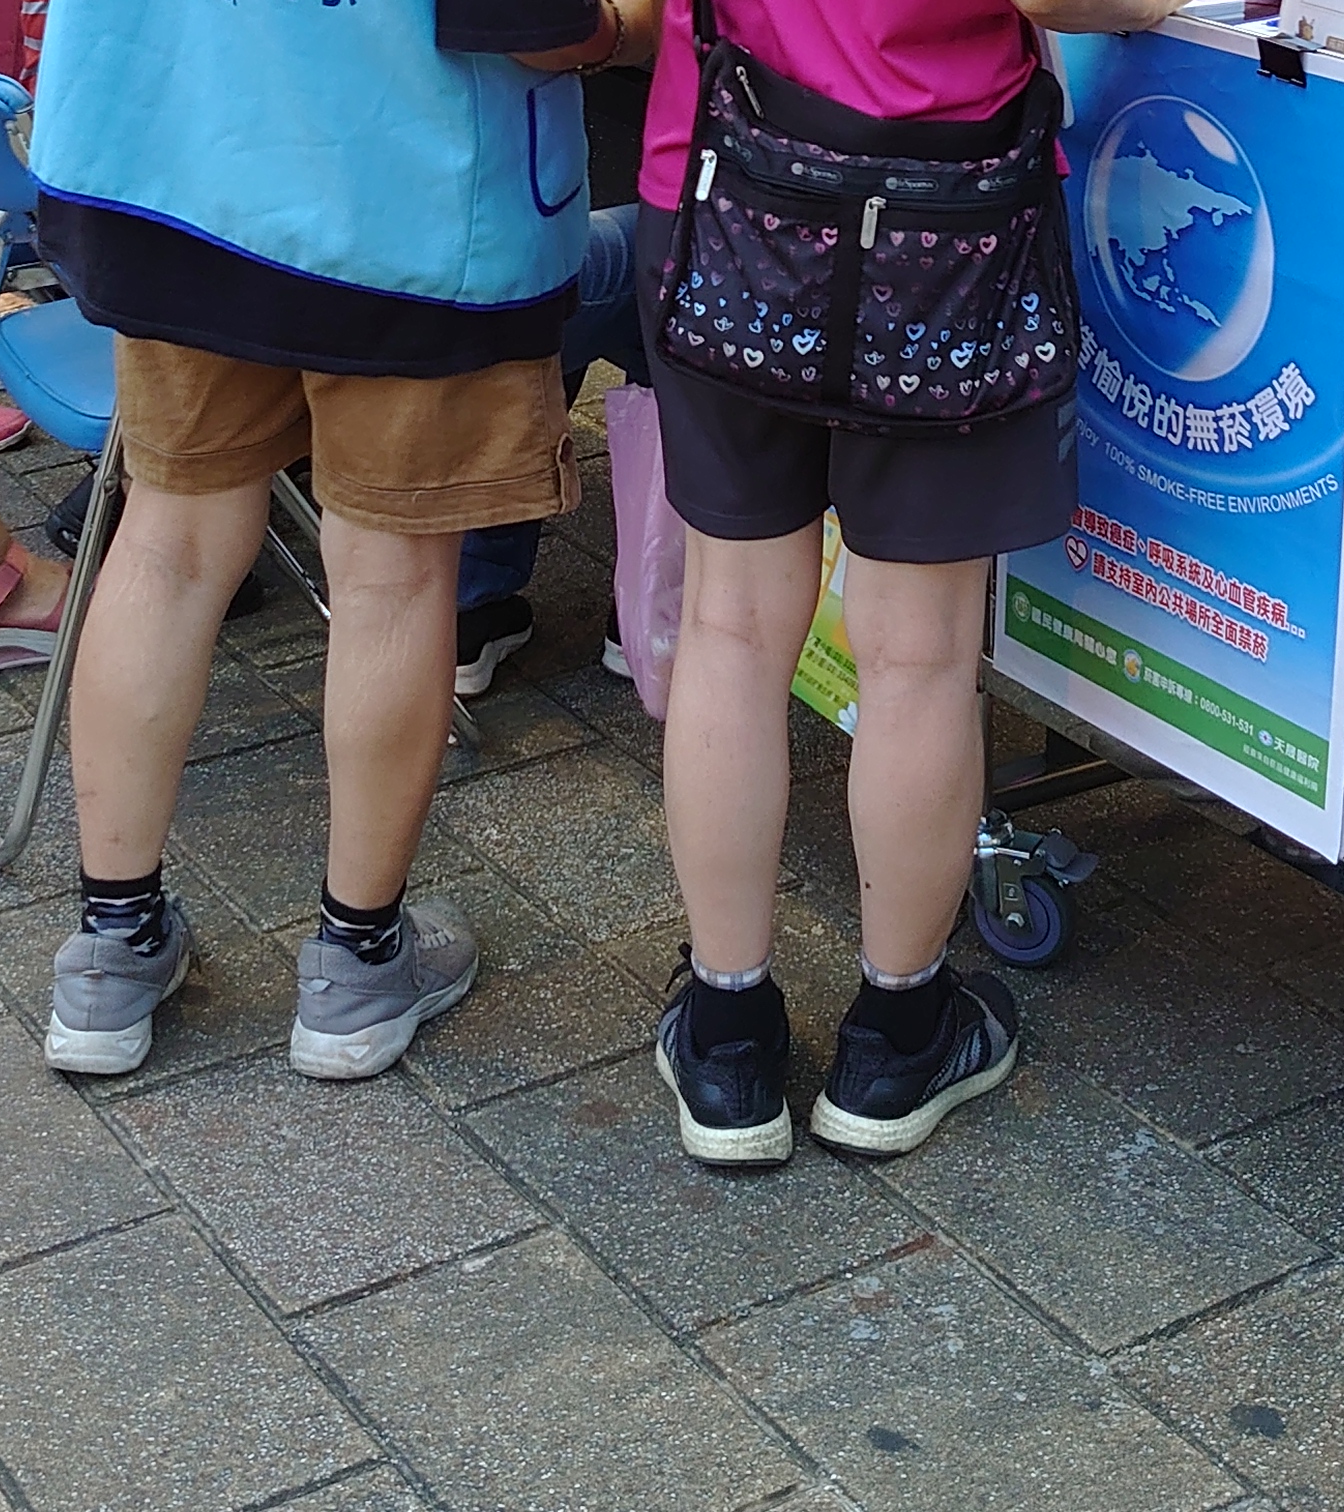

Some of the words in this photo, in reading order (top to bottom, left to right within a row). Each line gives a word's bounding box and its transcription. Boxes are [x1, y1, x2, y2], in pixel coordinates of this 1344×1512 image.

[1077, 418, 1100, 447] njoy
[1104, 441, 1136, 475] 100%
[1136, 464, 1226, 511] SMOKE-FREE
[1227, 473, 1340, 515] ENVIRONMENTS
[1091, 550, 1268, 662] 請支持室內公共場所全面禁菸
[1273, 736, 1320, 772] 天晟醫院
